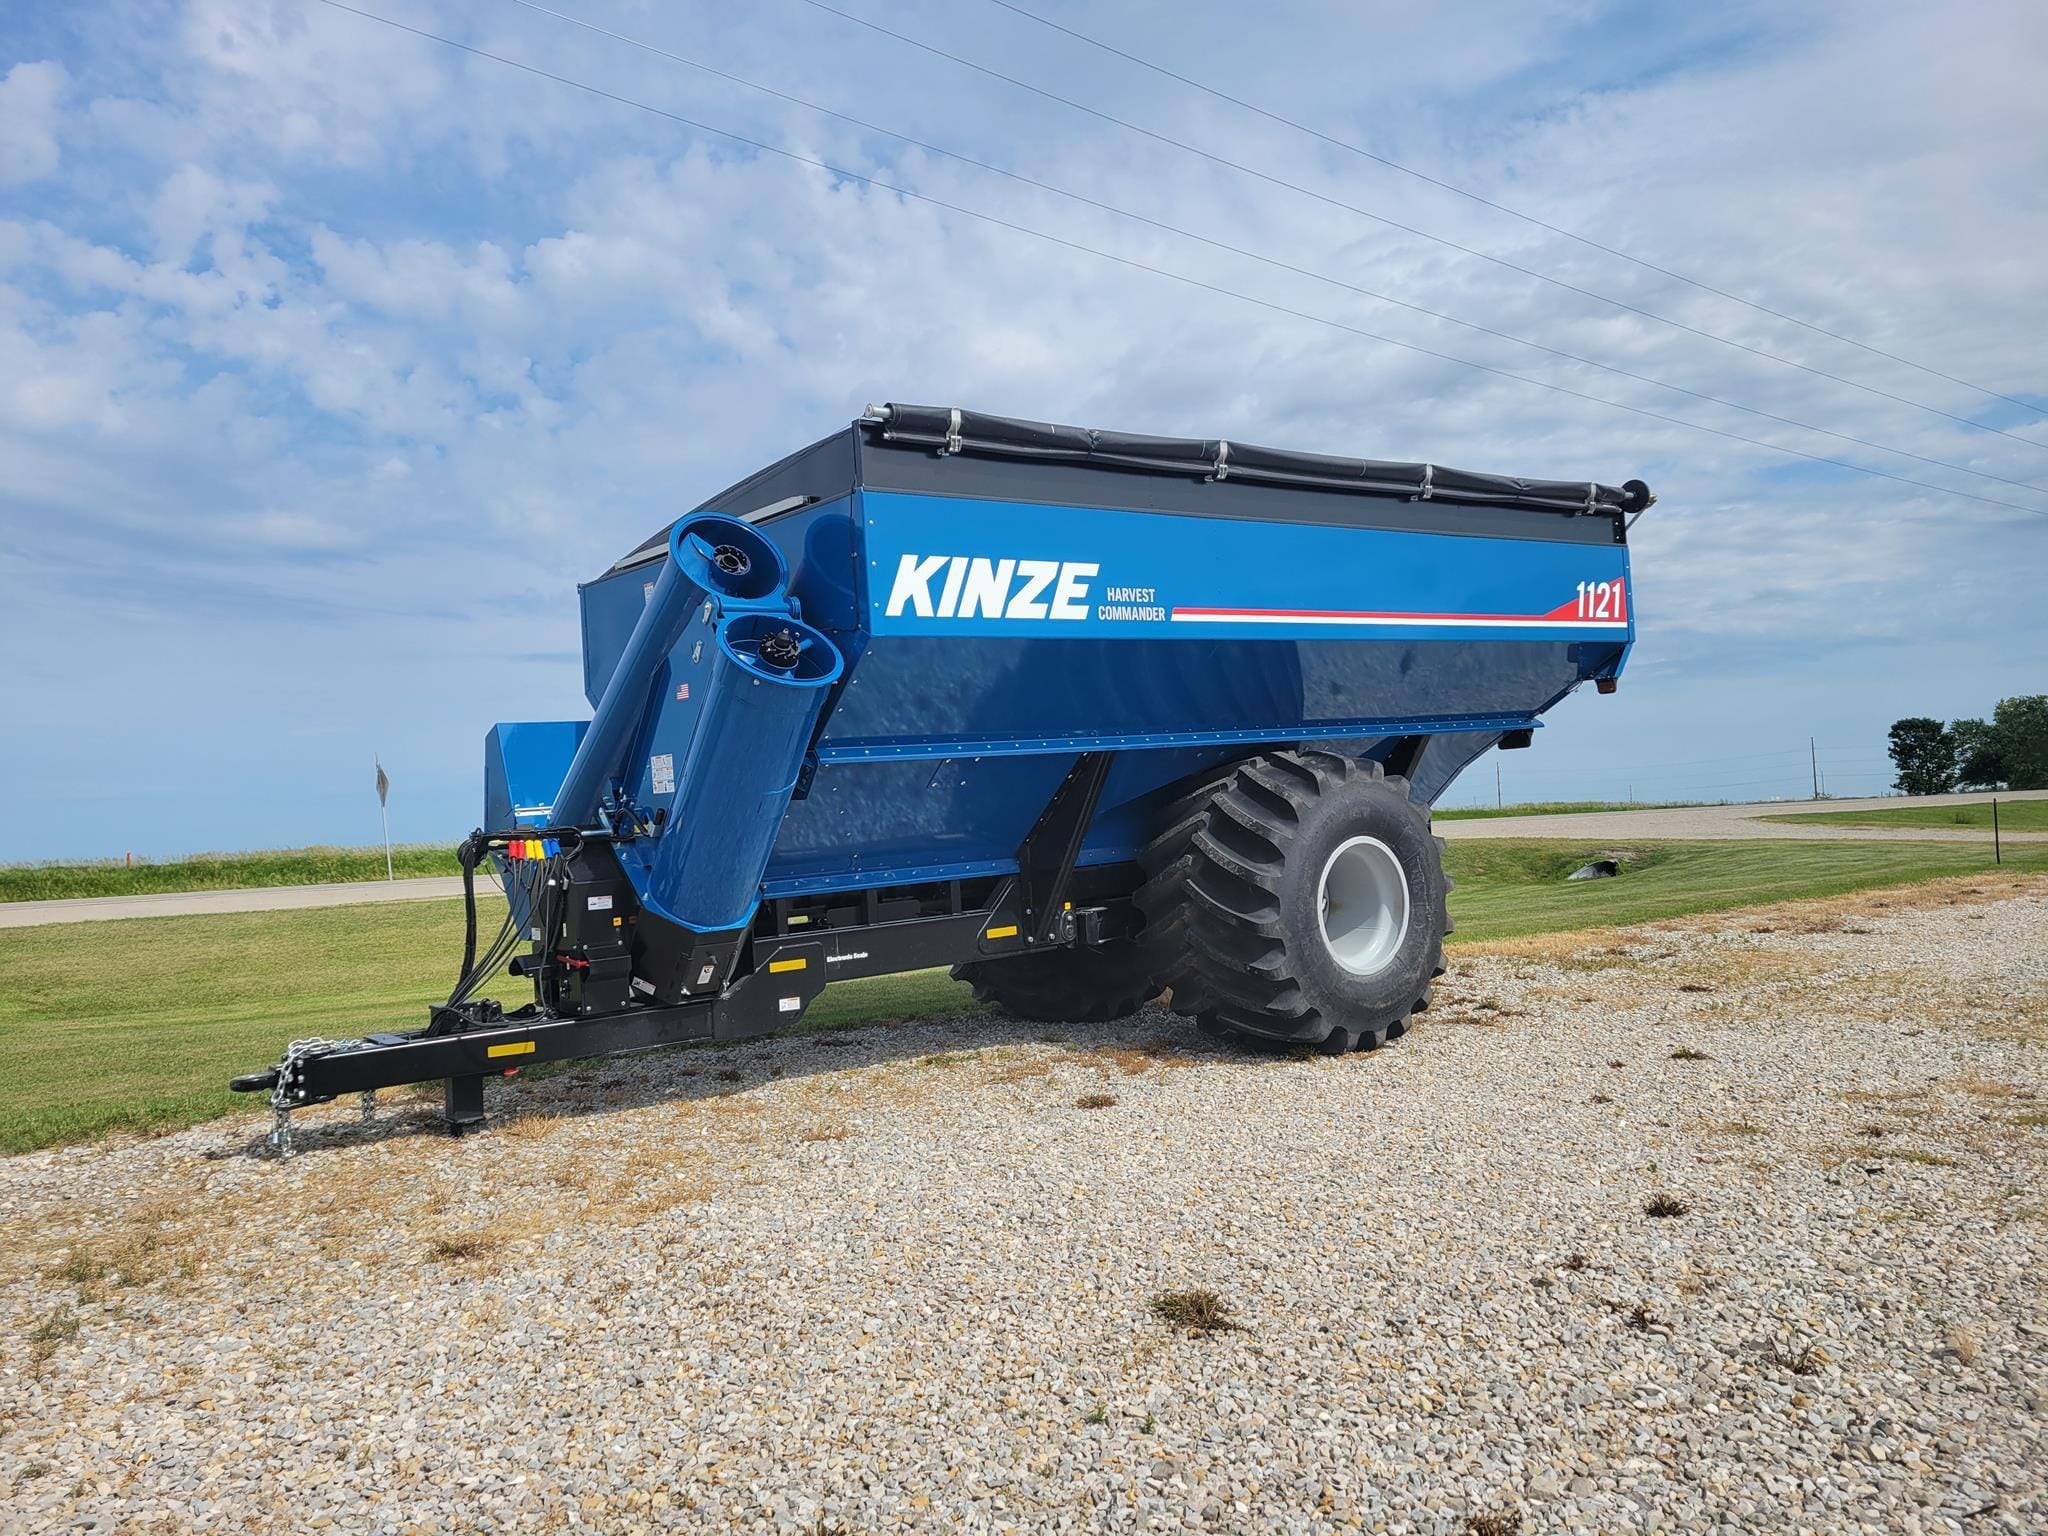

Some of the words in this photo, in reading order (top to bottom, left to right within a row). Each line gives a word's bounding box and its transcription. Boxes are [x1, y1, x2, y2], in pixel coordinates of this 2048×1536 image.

[885, 554, 1100, 620] KINZE
[1107, 587, 1155, 602] HARVEST
[1577, 581, 1621, 618] 1121
[1098, 605, 1165, 621] COMMANDER
